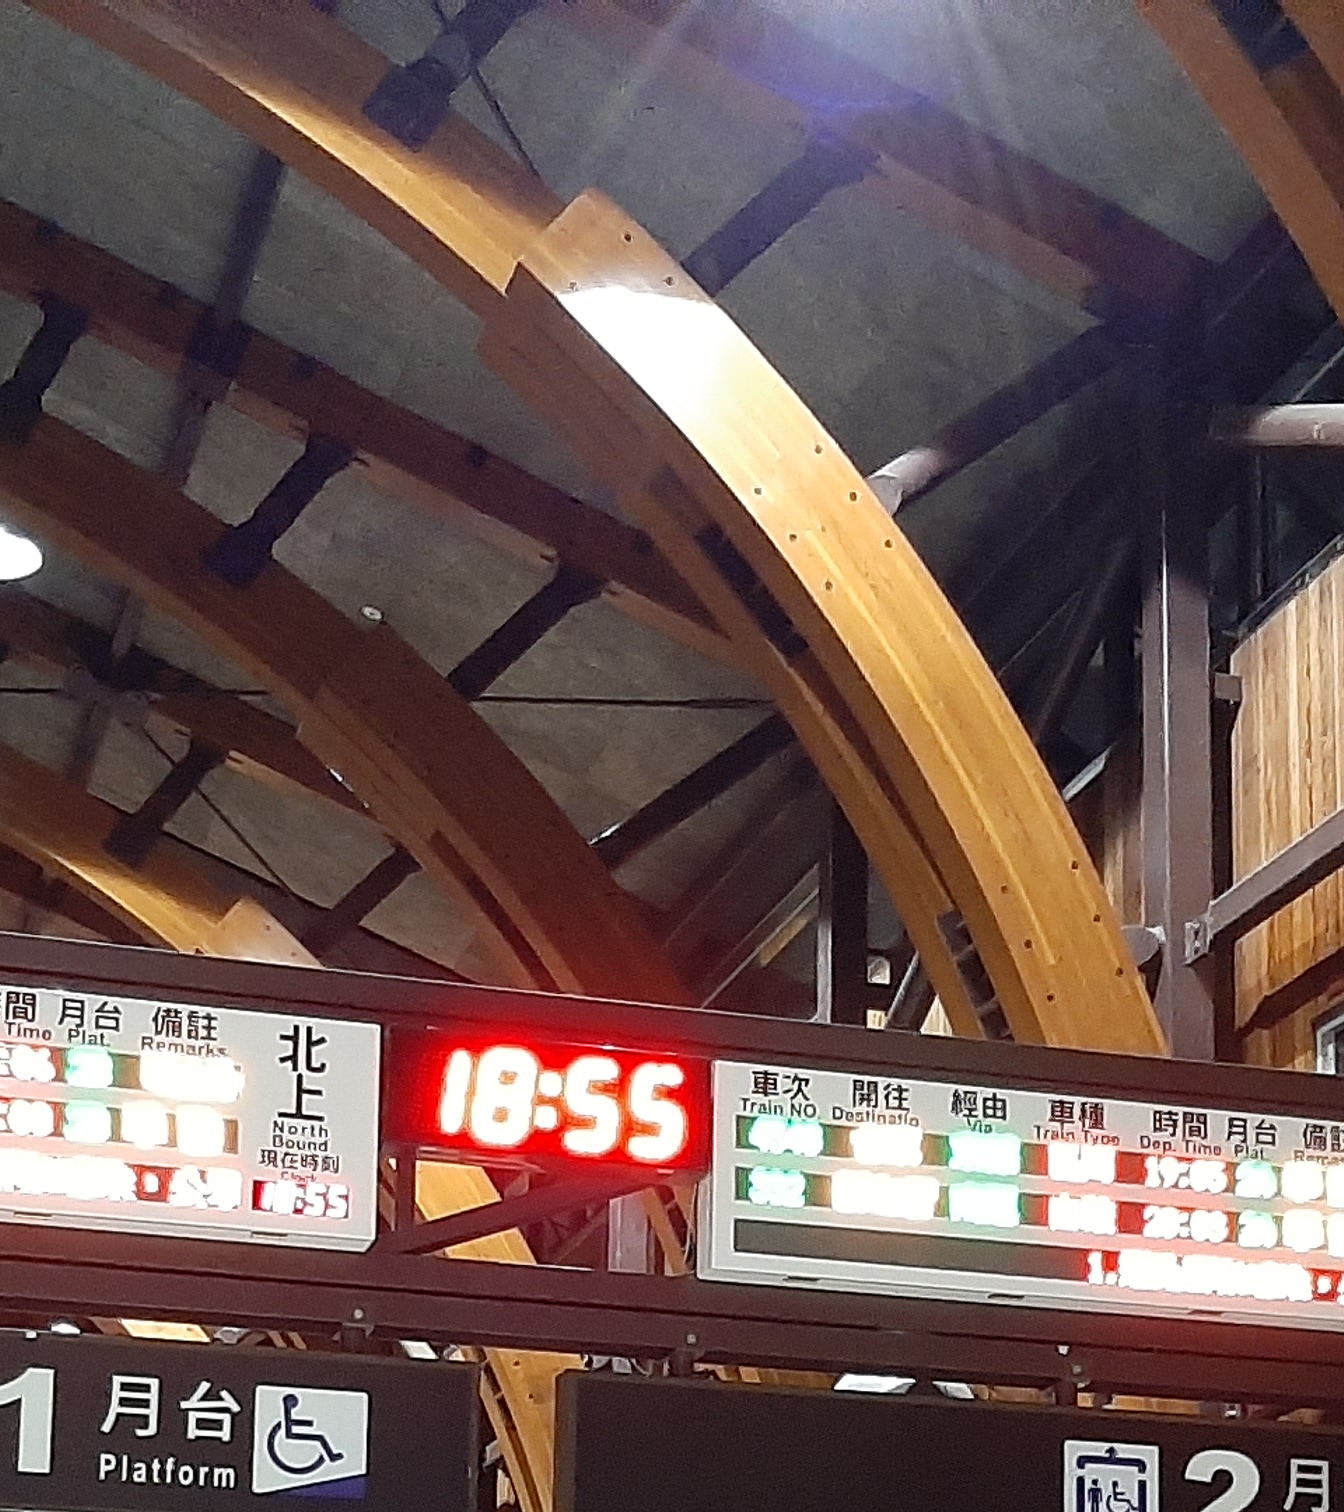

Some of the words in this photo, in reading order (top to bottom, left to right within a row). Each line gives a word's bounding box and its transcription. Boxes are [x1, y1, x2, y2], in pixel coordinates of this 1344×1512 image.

[4, 1021, 52, 1041] Time
[141, 1036, 227, 1057] Remarks
[57, 998, 123, 1033] 月台
[152, 1006, 218, 1042] 備註
[277, 1023, 328, 1122] 北上
[440, 1044, 687, 1161] 18:55
[741, 1097, 784, 1115] Train
[832, 1106, 921, 1128] Destinatio
[751, 1070, 810, 1101] 車次
[852, 1079, 910, 1113] 開往
[951, 1088, 1008, 1121] 經由
[1048, 1099, 1106, 1131] 車種
[1152, 1110, 1208, 1140] 時間
[1226, 1117, 1278, 1147] 月台
[272, 1134, 328, 1152] Bound
[273, 1120, 329, 1138] North
[100, 1375, 241, 1442] 月台
[98, 1453, 236, 1489] Platform
